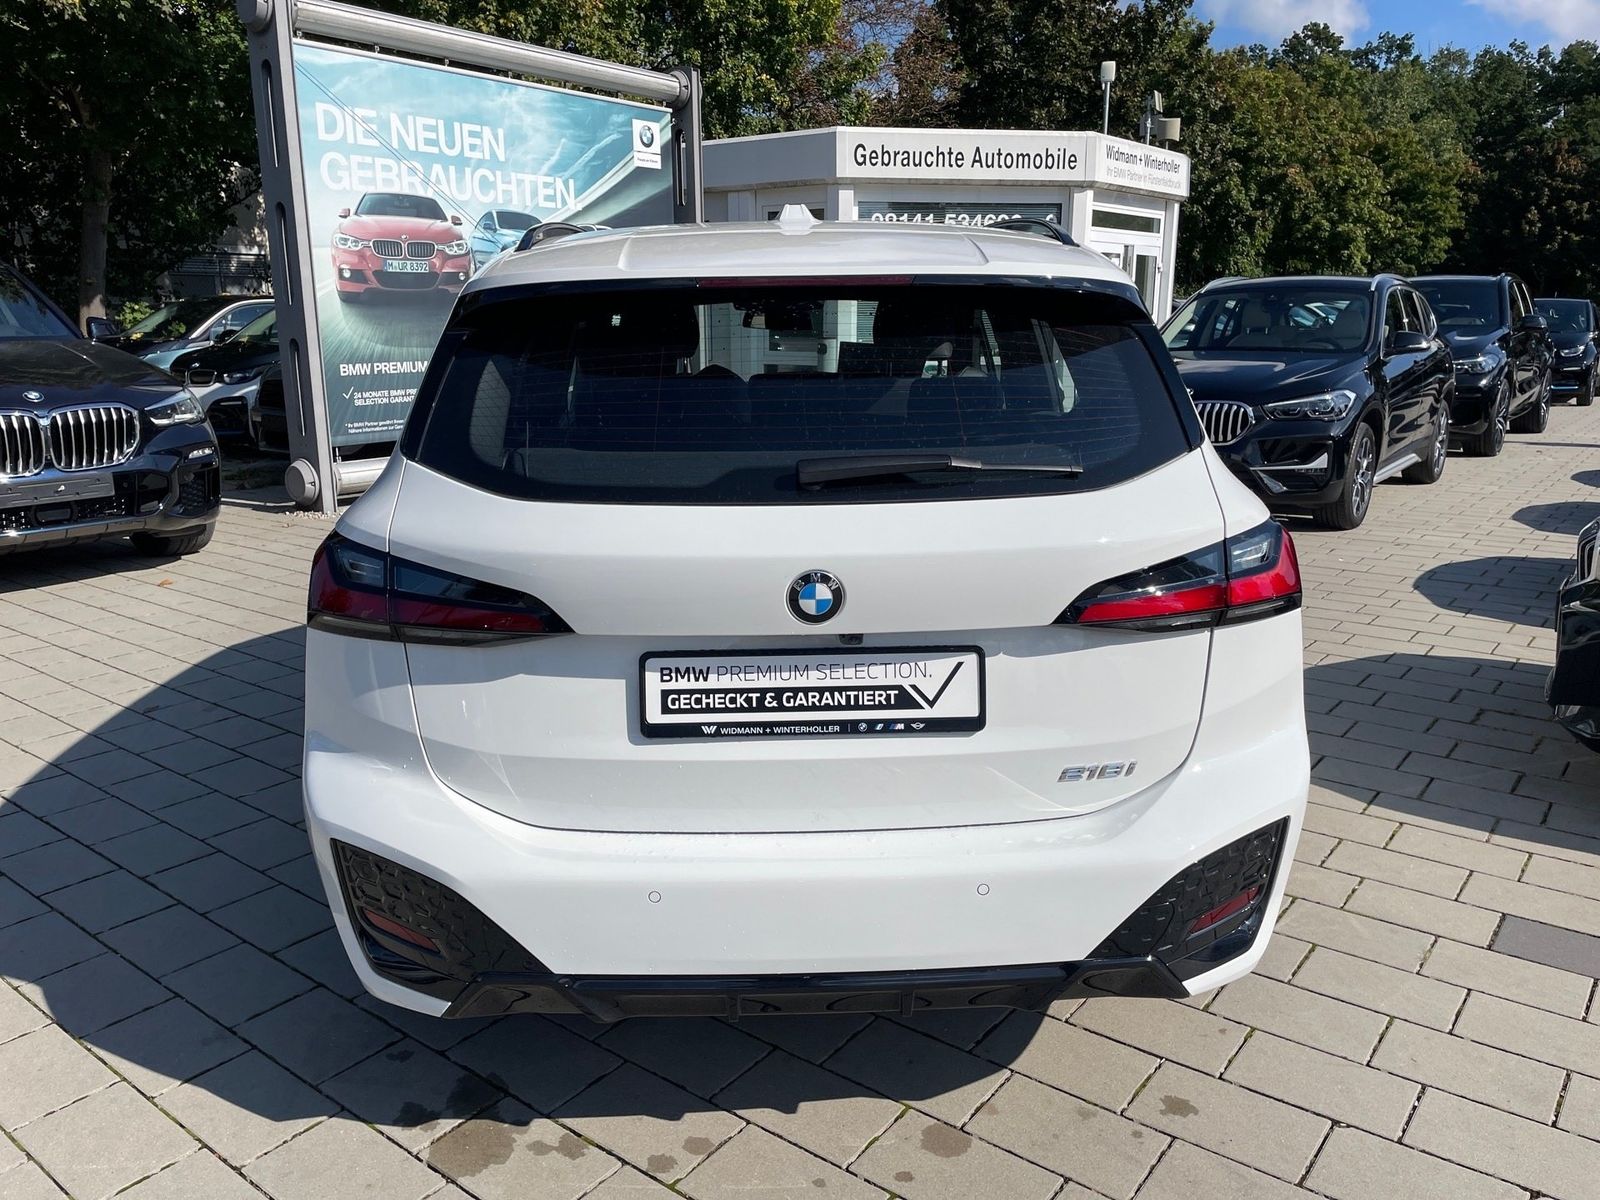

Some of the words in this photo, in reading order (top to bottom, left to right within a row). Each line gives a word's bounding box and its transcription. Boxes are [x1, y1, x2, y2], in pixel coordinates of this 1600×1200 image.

[314, 101, 378, 146] DIE
[390, 112, 506, 161] NEUEN
[853, 143, 965, 169] Gebrauchte
[971, 146, 1078, 171] Automobile
[1106, 144, 1138, 166] Widmann
[410, 262, 428, 271] 8392
[340, 363, 371, 377] BMW
[373, 361, 428, 375] PREMIUM
[660, 666, 710, 683] BMW
[716, 663, 809, 682] PREMIUM
[667, 692, 760, 710] GECHECKT
[764, 692, 777, 707] &
[782, 689, 899, 707] GARANTIERT
[720, 727, 763, 735] WIDMANN
[773, 724, 840, 734] WINTERHOLLER
